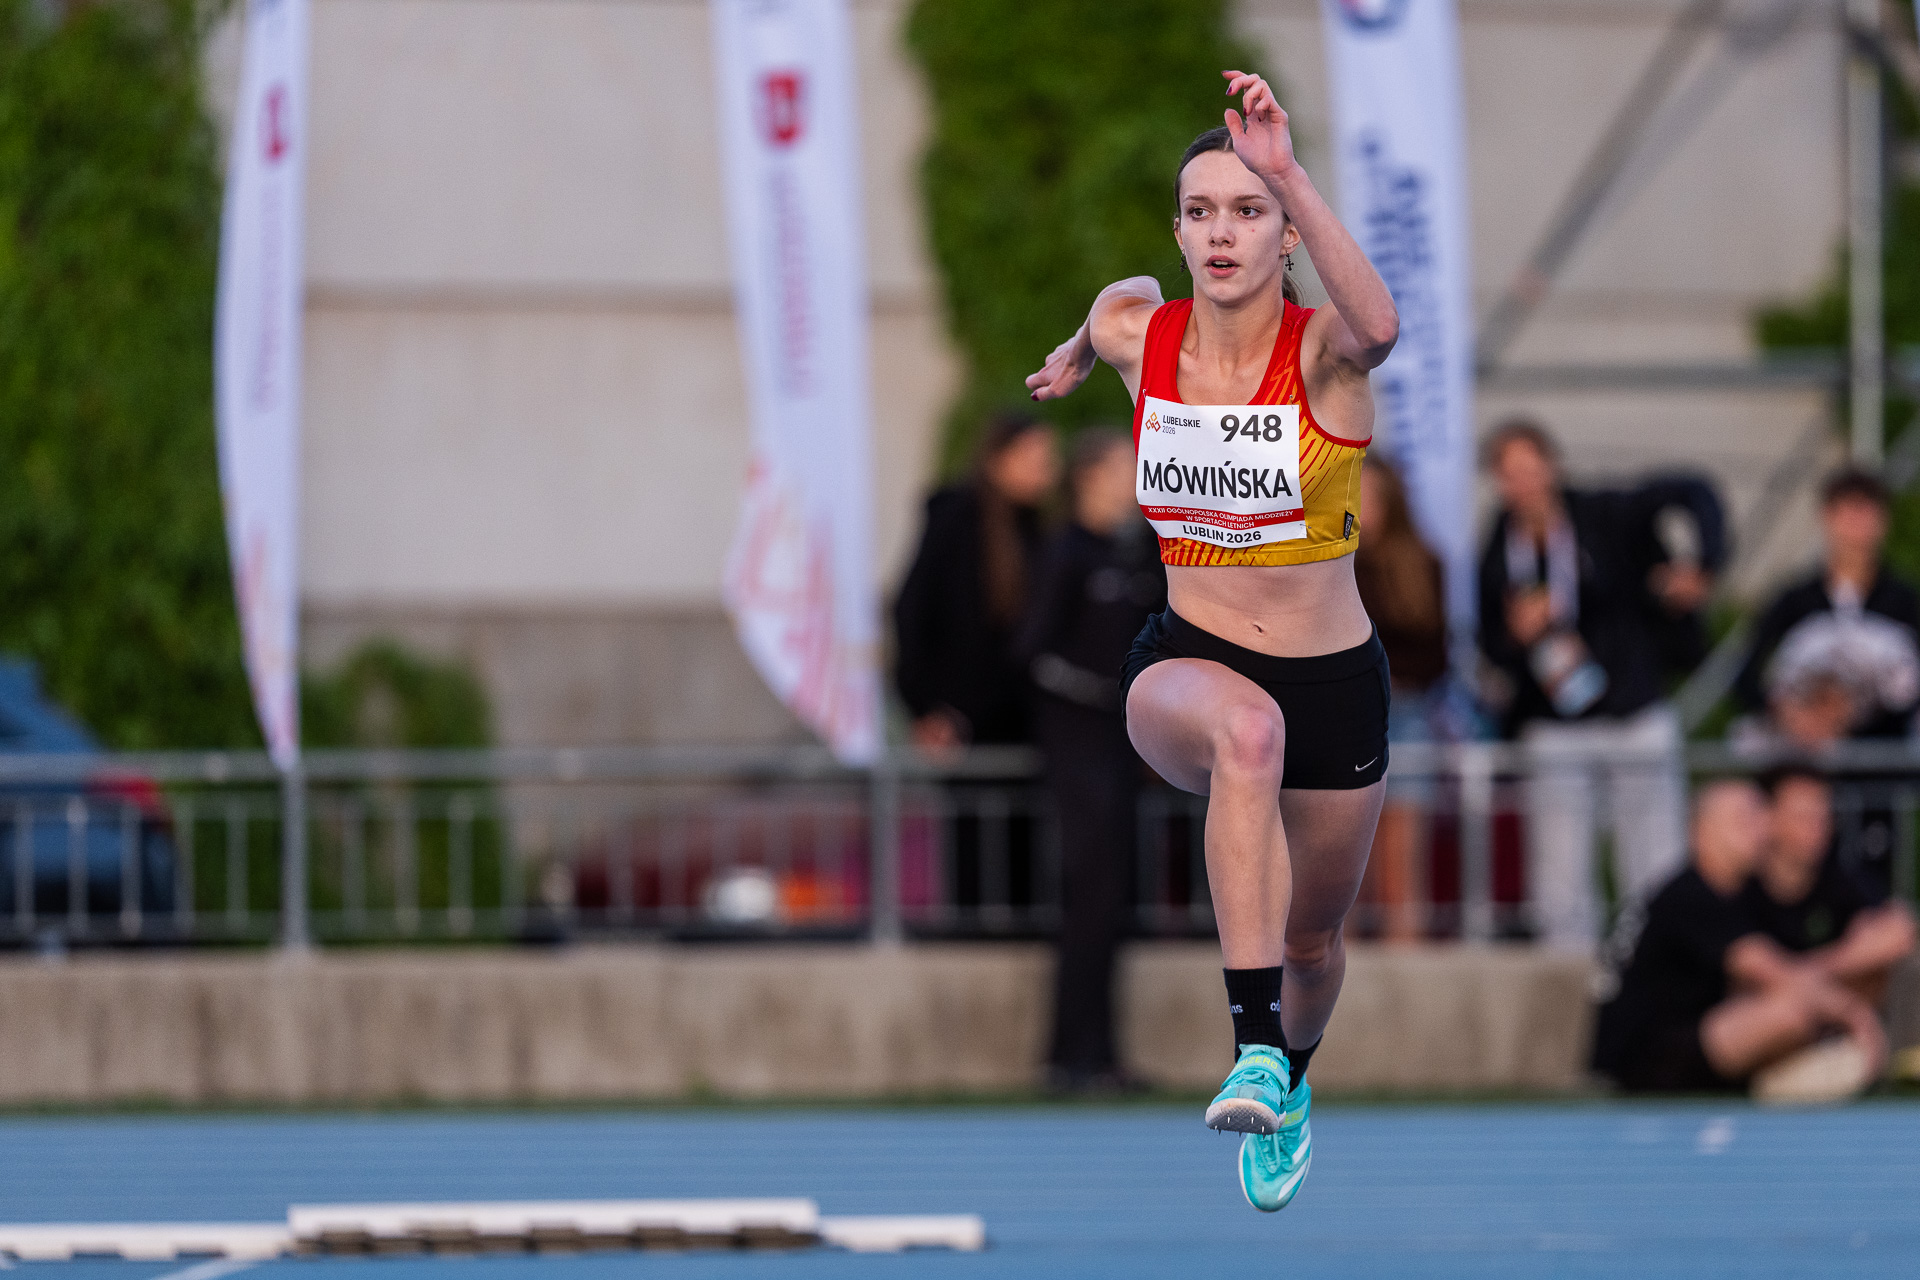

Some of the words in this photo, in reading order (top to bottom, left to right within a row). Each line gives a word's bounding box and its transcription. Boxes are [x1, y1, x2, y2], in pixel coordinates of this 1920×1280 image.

[1162, 415, 1201, 428] LUBELSKIE
[1220, 414, 1283, 443] 948
[1162, 426, 1176, 435] 2026
[1143, 457, 1293, 499] MÓWIŃSKA
[1166, 507, 1219, 518] OGÓLNOPOLSKA
[1219, 512, 1254, 522] OLIMPIADA
[1194, 515, 1227, 527] SPORTACH
[1227, 521, 1255, 529] LETNICH
[1183, 525, 1224, 541] LUBLIN
[1226, 531, 1262, 543] 2026
